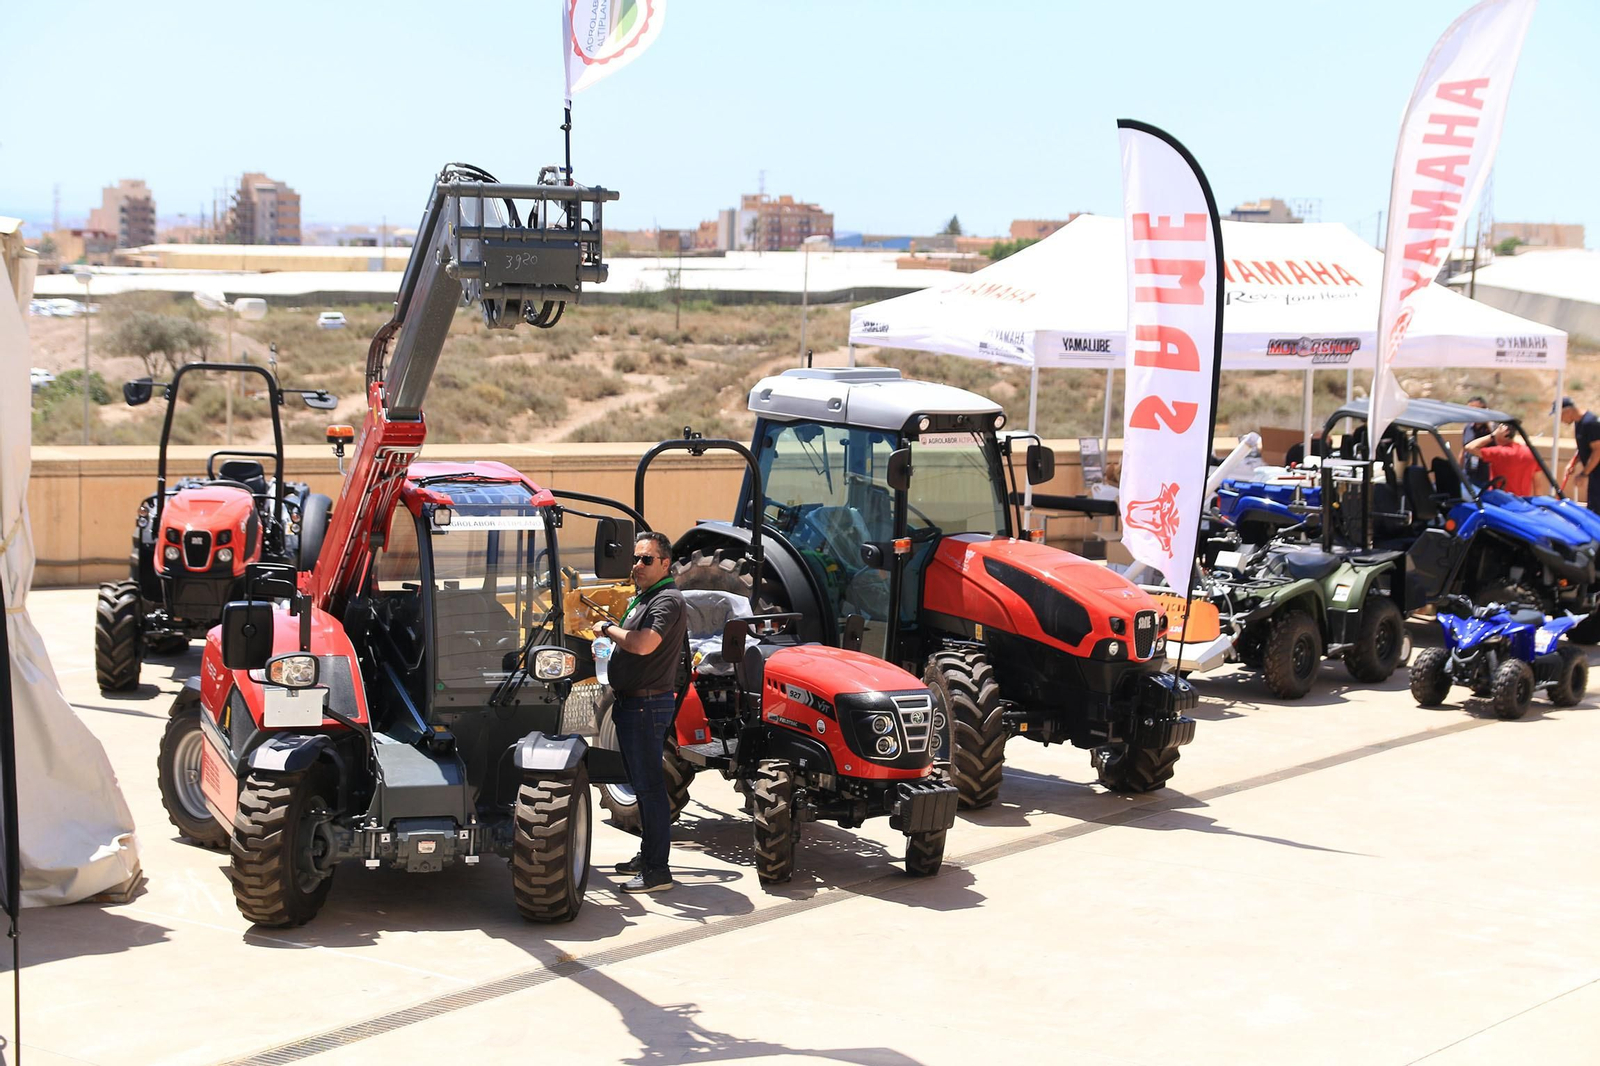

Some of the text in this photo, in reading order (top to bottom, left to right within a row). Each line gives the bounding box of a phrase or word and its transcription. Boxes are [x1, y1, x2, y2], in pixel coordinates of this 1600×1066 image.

[1400, 77, 1490, 301] YAMAHA
[505, 252, 538, 270] 3920
[1062, 337, 1112, 353] YAMALUBE
[1507, 336, 1548, 349] YAMAHA
[448, 519, 496, 527] GROLABOR
[789, 689, 802, 700] 927
